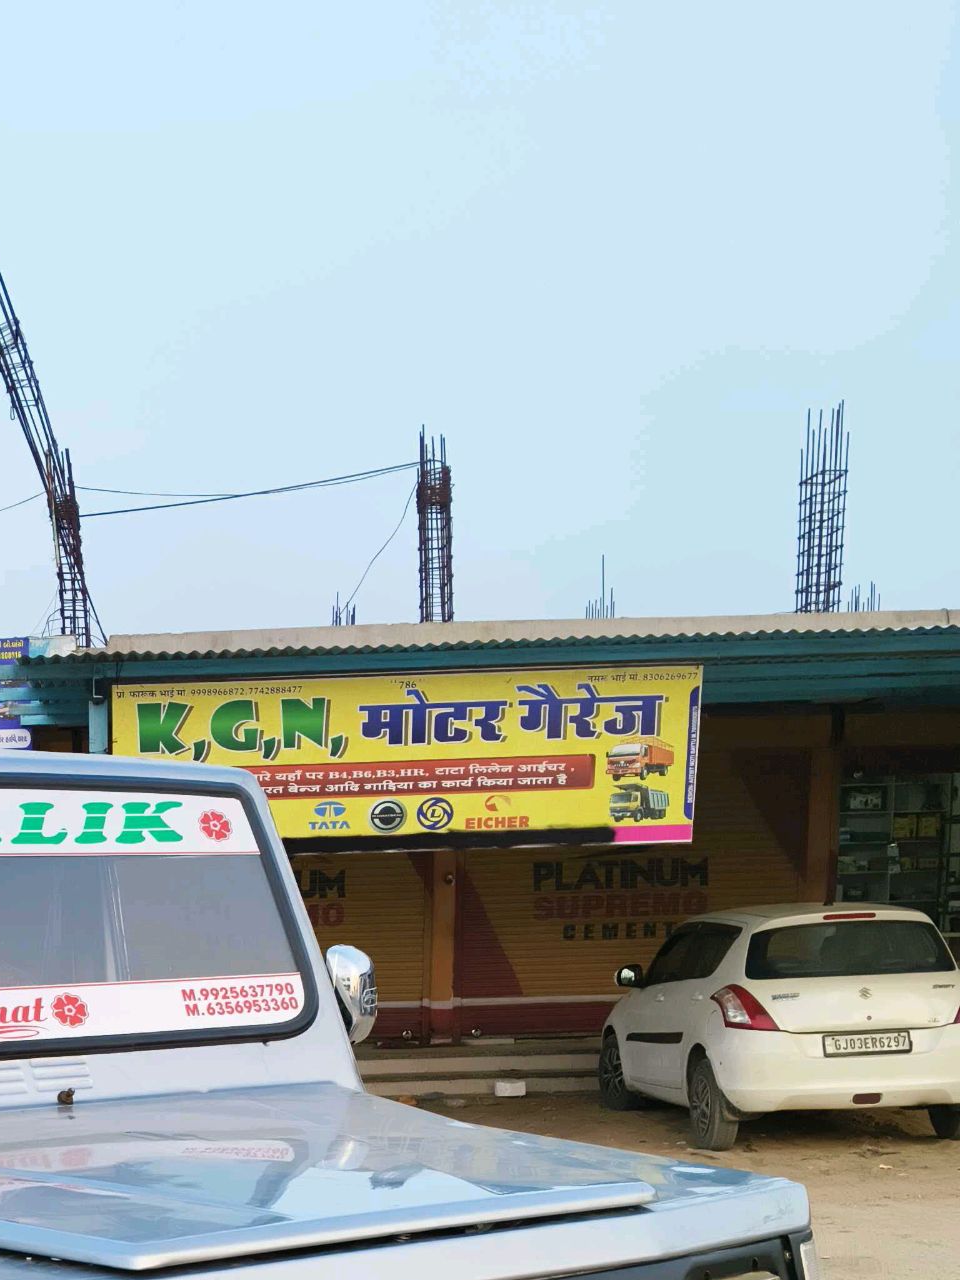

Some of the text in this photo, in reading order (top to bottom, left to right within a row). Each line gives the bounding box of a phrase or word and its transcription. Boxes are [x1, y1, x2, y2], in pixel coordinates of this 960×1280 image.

[159, 687, 175, 698] भाई
[359, 689, 510, 745] मोटर
[516, 683, 665, 739] गैरेज
[275, 769, 302, 781] यहाँ
[305, 771, 323, 780] पर
[435, 766, 465, 775] टाटा
[469, 763, 514, 774] लिलेन
[325, 781, 360, 792] आदि
[418, 780, 437, 789] का
[442, 776, 474, 788] कार्य
[477, 776, 514, 787] किया
[517, 775, 554, 785] जाता
[556, 773, 567, 785] है
[308, 820, 351, 830] TATA
[465, 816, 530, 830] EICHER
[533, 857, 709, 892] PLATINUM
[534, 890, 708, 921] SUPREMO
[181, 982, 295, 1002] M.9925637790
[185, 996, 299, 1017] M.6356953360
[834, 1036, 907, 1051] GJ03ER6297
